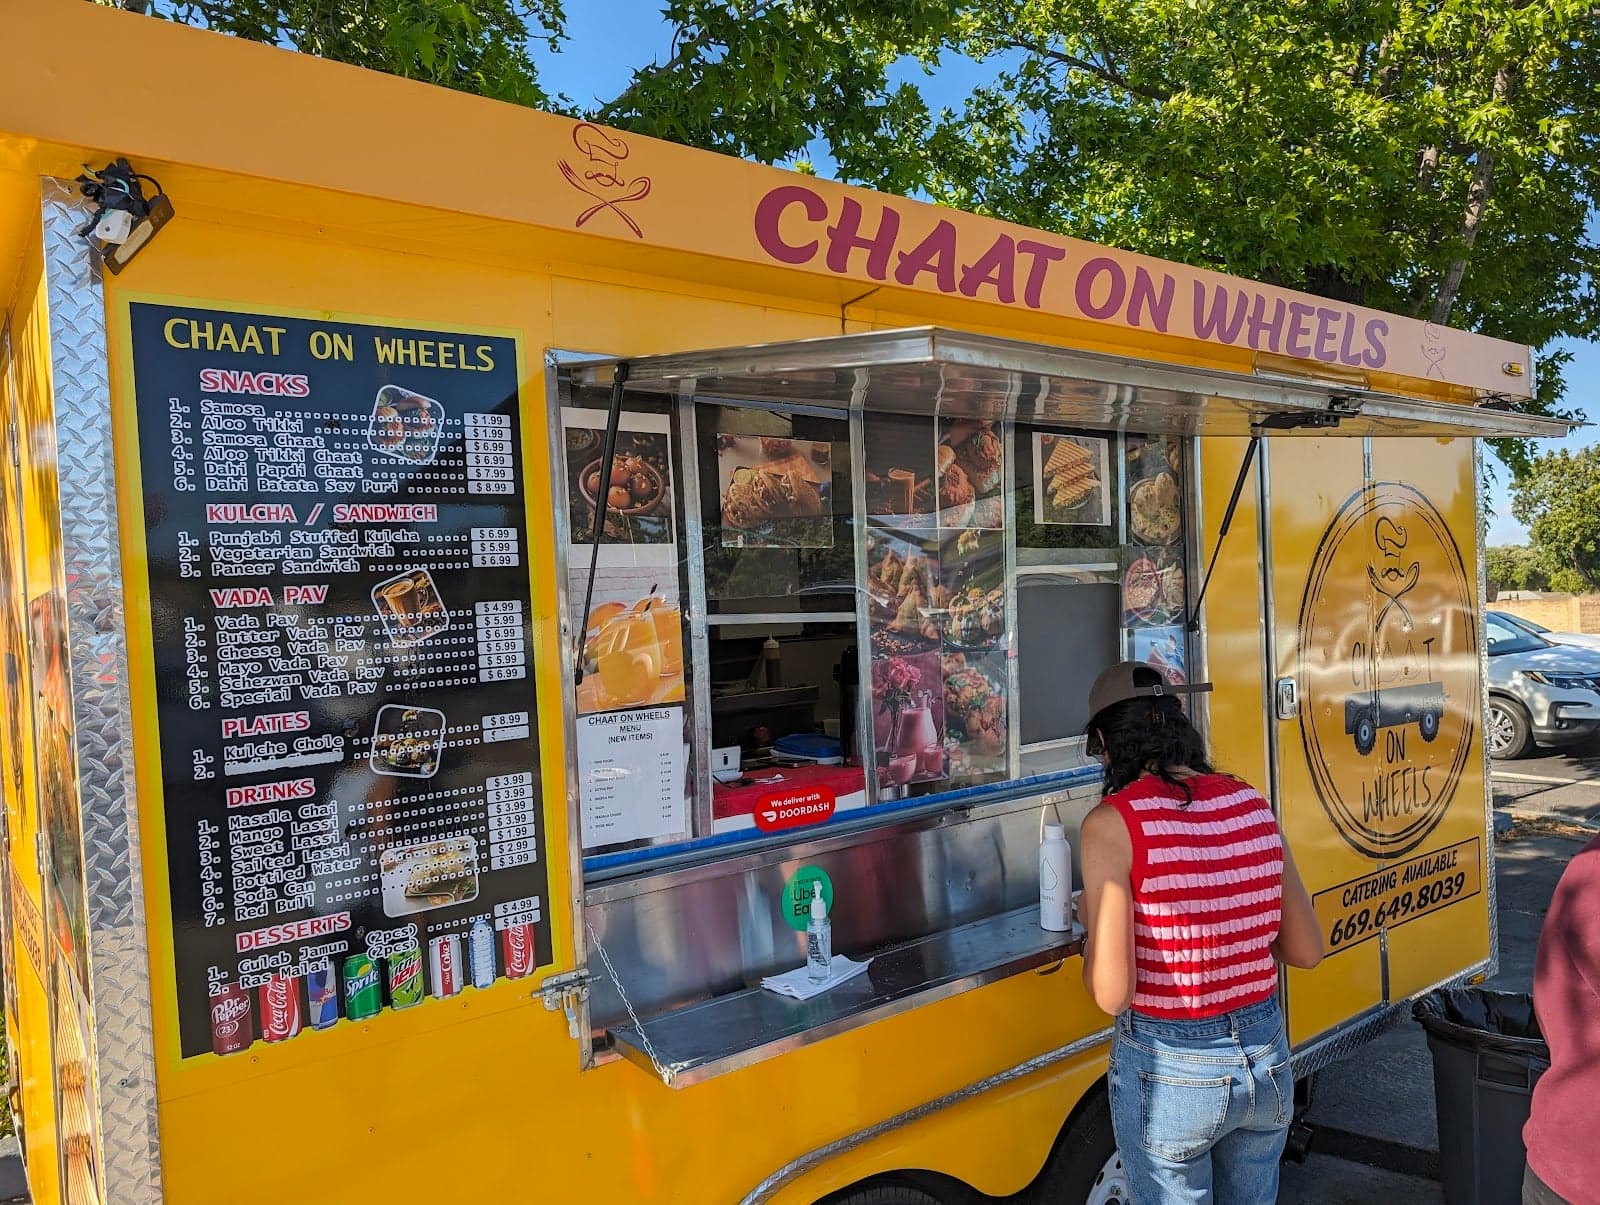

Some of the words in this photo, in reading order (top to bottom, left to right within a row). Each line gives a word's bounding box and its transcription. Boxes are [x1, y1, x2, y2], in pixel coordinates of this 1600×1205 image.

[755, 186, 1065, 308] CHAAT
[1075, 258, 1175, 333] ON
[1193, 280, 1389, 368] WHEELS
[163, 316, 287, 356] CHAAT
[308, 330, 353, 361] ON
[374, 336, 495, 372] WHEELS
[199, 368, 310, 396] SNACKS
[169, 399, 191, 413] 1.
[200, 400, 264, 416] Samosa
[170, 415, 192, 429] 2.
[201, 416, 245, 431] Aloo
[254, 418, 304, 433] Tikki
[171, 431, 193, 444] 3.
[202, 432, 266, 446] Samosa
[275, 434, 324, 448] Chaat
[172, 446, 194, 460] 4.
[203, 447, 247, 461] Aloo
[256, 449, 306, 462] Tikki
[315, 450, 363, 463] Chaat
[173, 462, 195, 476] 5.
[204, 463, 248, 476] Dahi
[256, 464, 307, 480] Papdi
[316, 465, 364, 478] Chaat
[174, 478, 196, 492] 6.
[205, 478, 249, 492] Dahi
[258, 479, 318, 492] Batata
[326, 480, 355, 492] Sev
[363, 480, 400, 492] Puri
[206, 504, 297, 524] KULCHA
[304, 503, 326, 525] /
[333, 504, 437, 523] SANDWICH
[178, 532, 200, 546] 1.
[208, 531, 282, 548] Punjabi
[291, 530, 358, 543] Stuffed
[366, 529, 420, 542] Kulcha
[179, 548, 201, 562] 2.
[210, 545, 312, 564] Vegetarian
[320, 543, 395, 557] Sandwich
[180, 563, 202, 577] 3.
[211, 561, 274, 576] Paneer
[283, 559, 360, 573] Sandwich
[209, 587, 273, 608] VADA
[283, 584, 329, 604] PAV
[184, 618, 205, 632] 1.
[214, 615, 257, 630] Vada
[266, 613, 297, 627] Pav
[184, 633, 206, 648] 2.
[215, 629, 278, 646] Butter
[287, 626, 327, 641] Vada
[335, 623, 364, 637] Pav
[186, 649, 207, 663] 3.
[216, 644, 279, 661] Cheese
[288, 640, 328, 655] Vada
[336, 638, 365, 652] Pav
[187, 664, 208, 679] 4.
[217, 660, 261, 679] Mayo
[269, 656, 310, 672] Vada
[318, 653, 347, 668] Pav
[188, 680, 209, 695] 5.
[218, 672, 301, 692] Schezwan
[309, 668, 348, 683] Vada
[356, 665, 384, 679] Pav
[189, 695, 210, 710] 6.
[219, 688, 292, 710] Special
[301, 683, 340, 699] Vada
[348, 680, 376, 694] Pav
[221, 710, 310, 739] PLATES
[588, 715, 617, 725] CHAAT
[620, 713, 633, 722] ON
[636, 711, 670, 720] WHEELS
[192, 748, 214, 764] 1.
[223, 740, 286, 760] Kulche
[294, 733, 343, 751] Chole
[608, 735, 627, 744] (NEW
[628, 732, 653, 741] ITEMS)
[1387, 728, 1406, 765] ON
[194, 764, 215, 780] 2.
[226, 777, 315, 808] DRINKS
[771, 798, 782, 808] We
[783, 794, 806, 806] deliver
[807, 792, 820, 803] with
[1362, 767, 1434, 823] WHEELS
[197, 818, 219, 834] 1.
[227, 807, 290, 830] Masala
[298, 800, 338, 818] Chai
[779, 802, 830, 819] DOORDASH
[198, 834, 220, 850] 2.
[228, 824, 281, 848] Mango
[290, 814, 339, 835] Lassi
[199, 849, 221, 865] 3.
[230, 839, 282, 860] Sweet
[291, 829, 340, 849] Lassi
[200, 864, 222, 881] 4.
[230, 852, 293, 875] Salted
[301, 842, 350, 862] Lassi
[201, 879, 223, 896] 5.
[232, 865, 303, 890] Bottled
[312, 854, 360, 875] Water
[1343, 871, 1397, 907] CATERING
[1402, 850, 1458, 885] AVAILABLE
[202, 895, 224, 911] 6.
[232, 885, 275, 906] Soda
[284, 877, 314, 895] Can
[203, 910, 225, 927] 7.
[234, 902, 266, 921] Red
[275, 892, 315, 912] Bull
[1330, 872, 1465, 946] 669.649.8039
[235, 910, 351, 953] DESSERTS
[207, 964, 228, 982] 1.
[237, 951, 289, 975] Gulab
[298, 938, 346, 961] Jamun
[366, 921, 418, 948] (2pcs)
[208, 979, 229, 997] 2.
[238, 970, 270, 990] Ras
[279, 956, 328, 980] Malai
[367, 935, 418, 962] (2pcs)
[346, 968, 379, 997] Sprite
[212, 999, 249, 1024] Pepper
[223, 997, 240, 1008] Dr
